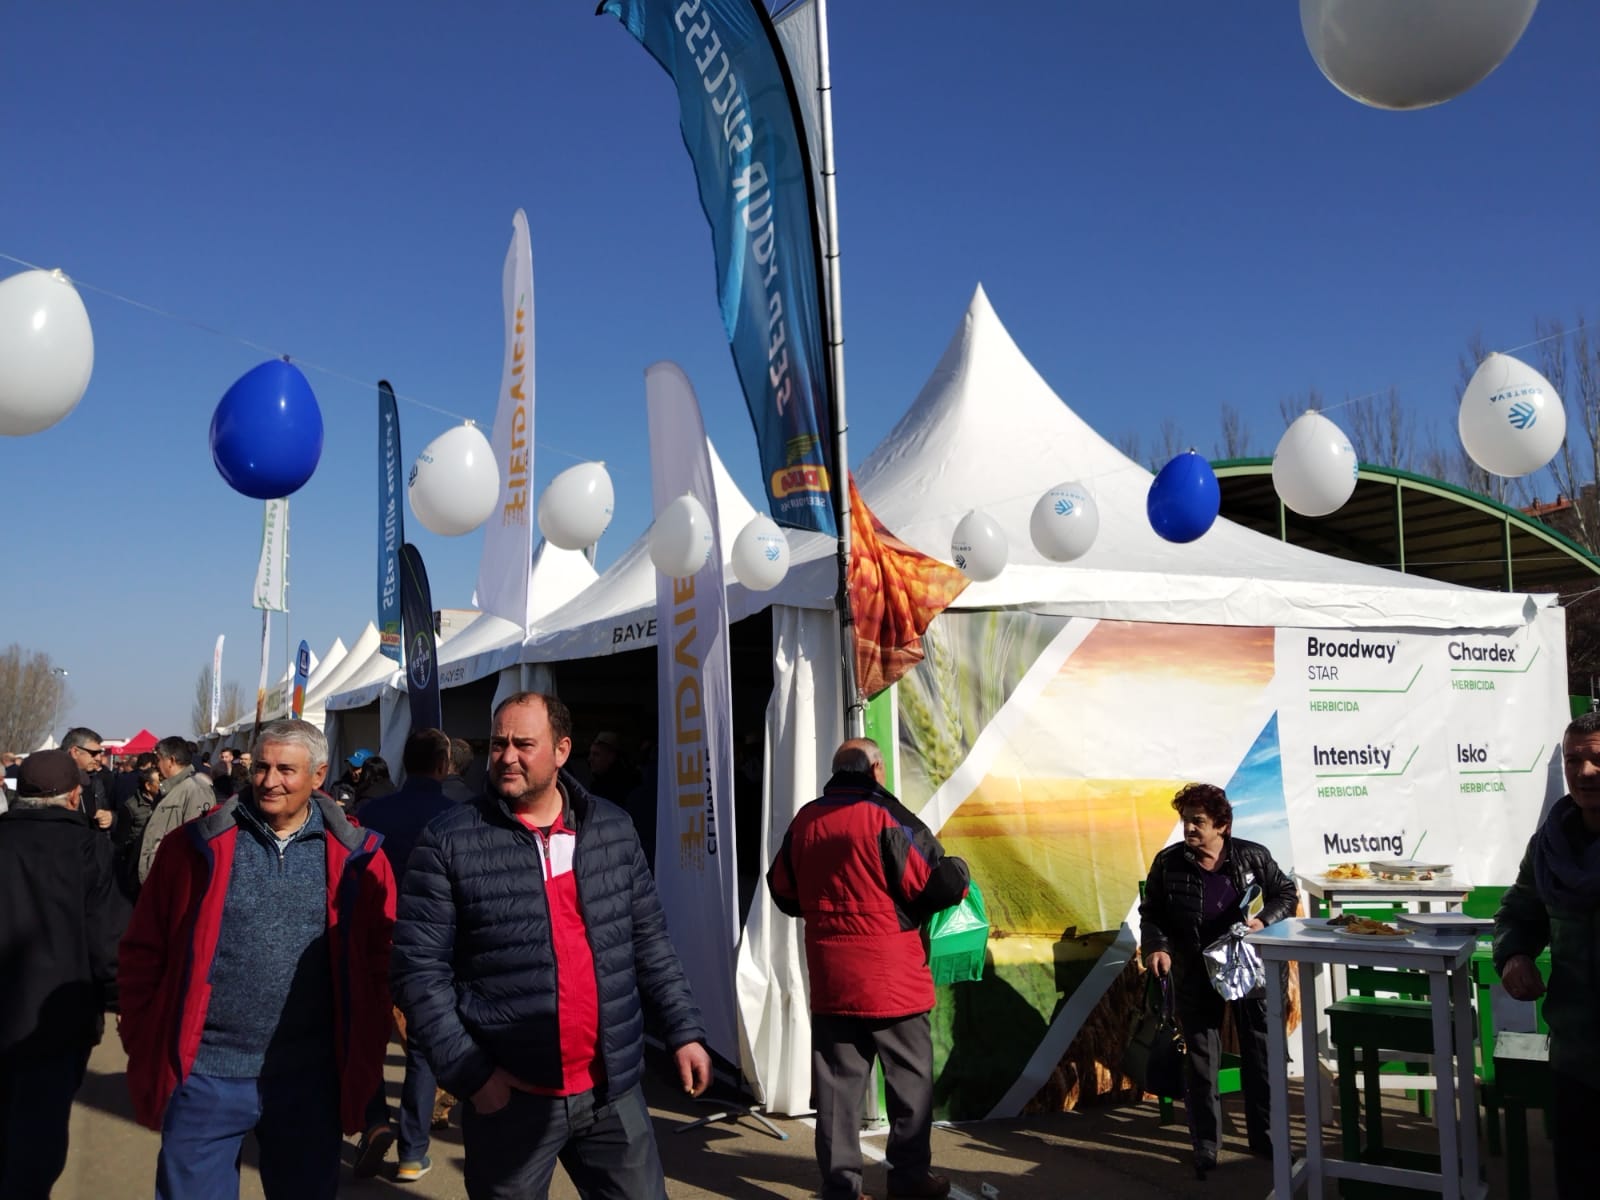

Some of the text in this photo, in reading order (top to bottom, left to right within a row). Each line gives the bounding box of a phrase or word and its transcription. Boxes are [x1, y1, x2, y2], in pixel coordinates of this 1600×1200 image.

[1490, 388, 1543, 403] CORTEVA
[612, 618, 657, 644] BAYE
[1307, 636, 1396, 664] Broadway
[1448, 642, 1516, 663] Chardex
[1308, 665, 1339, 680] STAR
[1452, 680, 1495, 691] HERBICIDA
[1310, 701, 1360, 712] HERBICIDA
[1313, 745, 1391, 769] Intensity
[1457, 744, 1487, 763] Isko
[1318, 786, 1368, 797] HERBICIDA
[1460, 782, 1506, 793] HERBICIDA
[1324, 832, 1403, 856] Mustang
